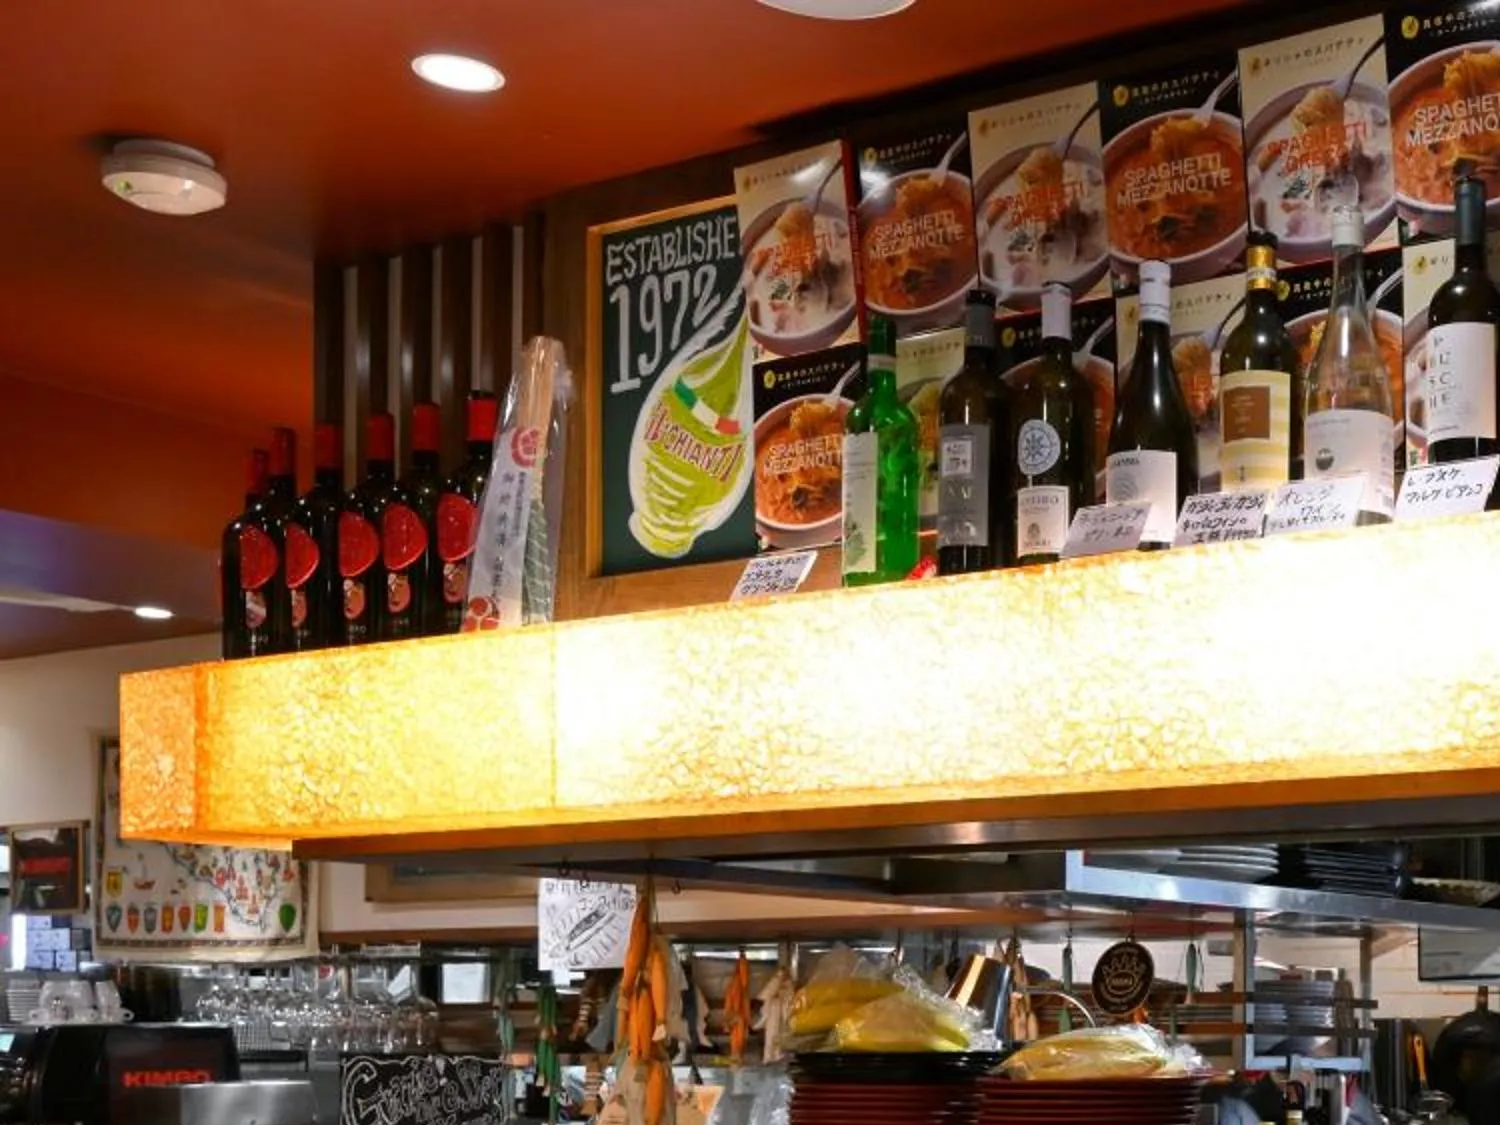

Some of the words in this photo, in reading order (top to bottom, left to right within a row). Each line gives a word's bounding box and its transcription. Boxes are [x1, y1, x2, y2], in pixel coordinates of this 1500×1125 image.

[1124, 151, 1222, 186] SPAGHETTI
[1116, 167, 1232, 208] MEZZANOTTE
[874, 210, 958, 241] SPAGHETTI
[605, 214, 737, 287] ESTABLISHE
[608, 263, 721, 394] 1972
[764, 446, 843, 476] MEZZANOT
[768, 434, 843, 459] SPAGHETT
[122, 1070, 211, 1088] KIMBO
